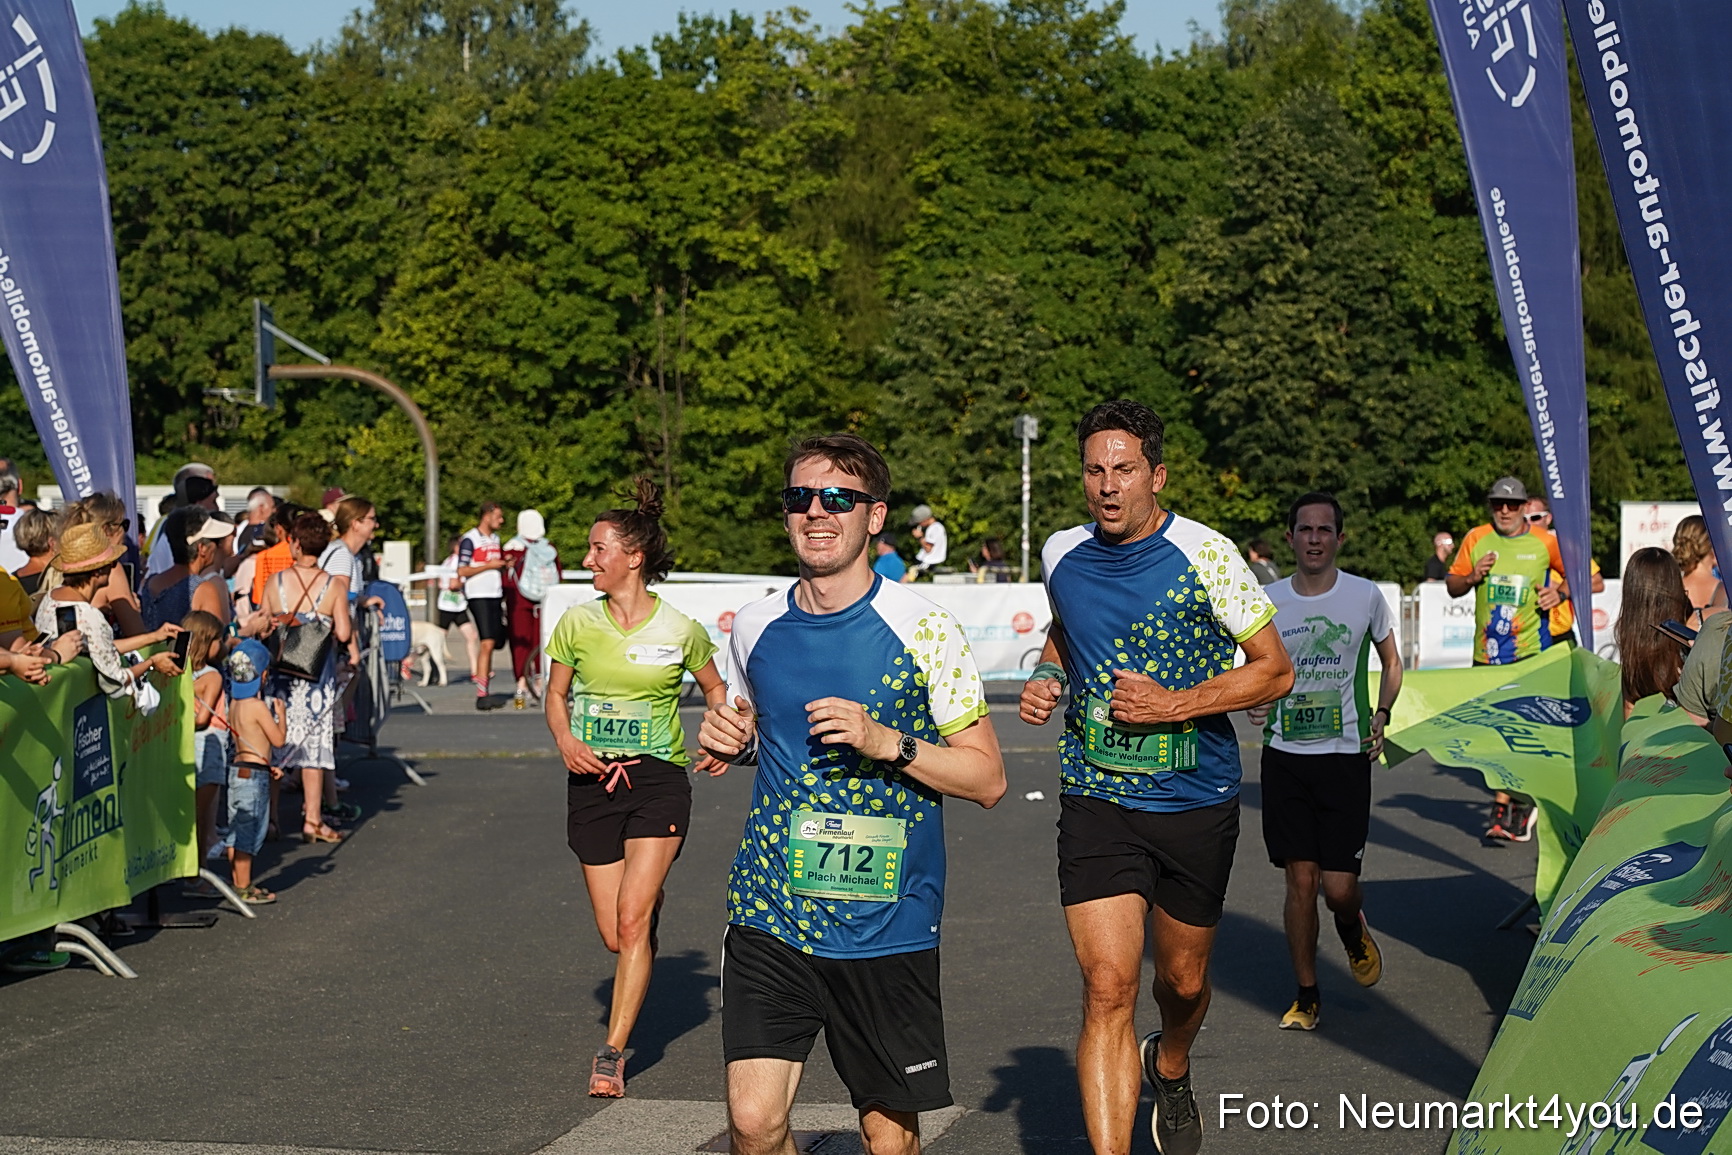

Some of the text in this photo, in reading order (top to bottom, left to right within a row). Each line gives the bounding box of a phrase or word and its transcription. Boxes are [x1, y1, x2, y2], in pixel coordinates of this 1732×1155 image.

[1282, 625, 1310, 638] BERATA
[1296, 668, 1349, 681] rfolgreich
[1294, 707, 1326, 724] 497
[1332, 708, 1341, 731] 2022
[585, 722, 593, 741] RUN
[593, 719, 640, 737] 1476
[640, 722, 649, 747] 2022
[591, 734, 624, 744] Rupprecht
[1088, 727, 1097, 751] RUN
[1102, 726, 1149, 753] 847
[1094, 745, 1118, 759] Reiser
[1118, 752, 1159, 764] Wolfgang
[1158, 734, 1168, 764] 2022
[819, 828, 856, 838] Firmenlauf
[793, 849, 805, 879] RUN
[816, 842, 875, 873] 712
[807, 871, 879, 886] Plach Michael
[883, 851, 897, 890] 2022
